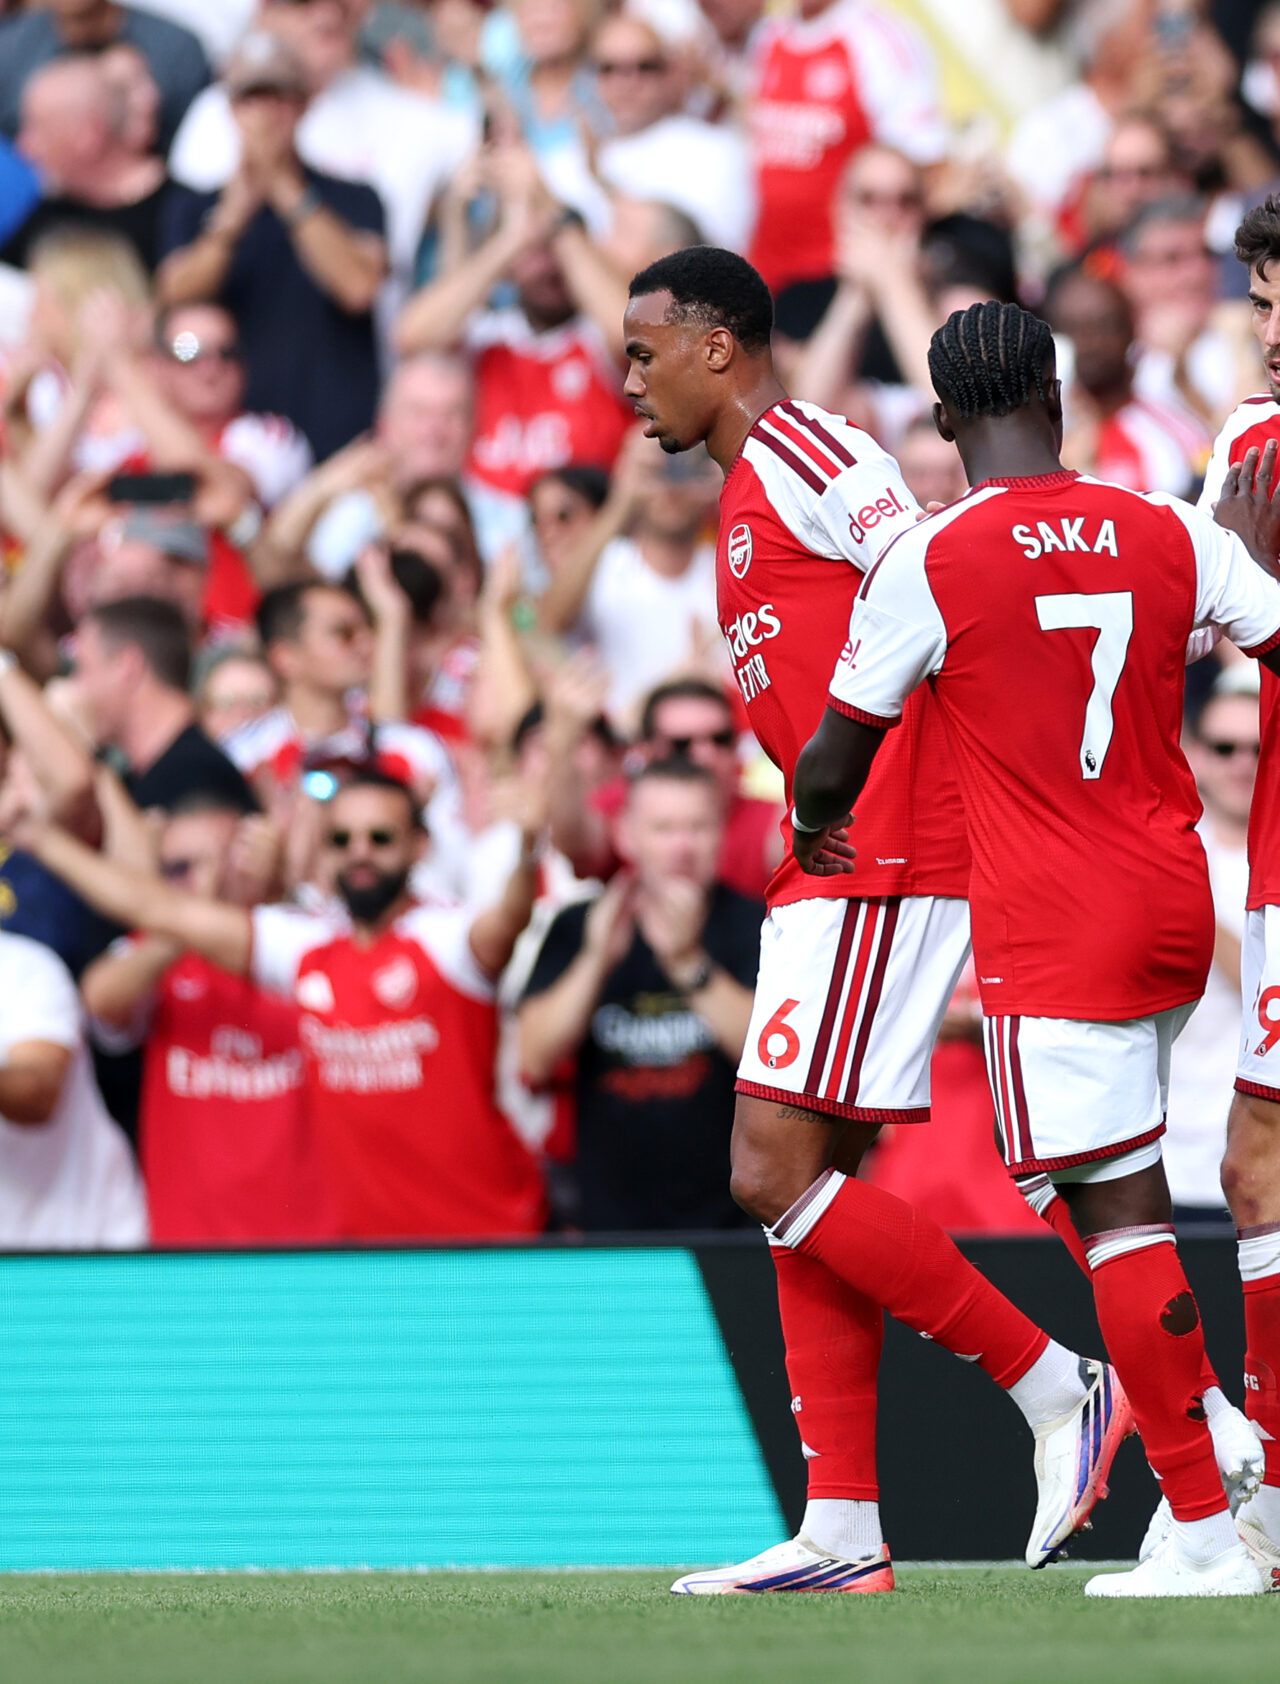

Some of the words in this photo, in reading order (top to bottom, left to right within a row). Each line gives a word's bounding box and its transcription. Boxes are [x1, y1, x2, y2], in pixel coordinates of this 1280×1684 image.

[848, 487, 909, 544] deel.
[1012, 517, 1119, 559] SAKA
[1034, 591, 1133, 780] 7
[758, 998, 800, 1070] 6
